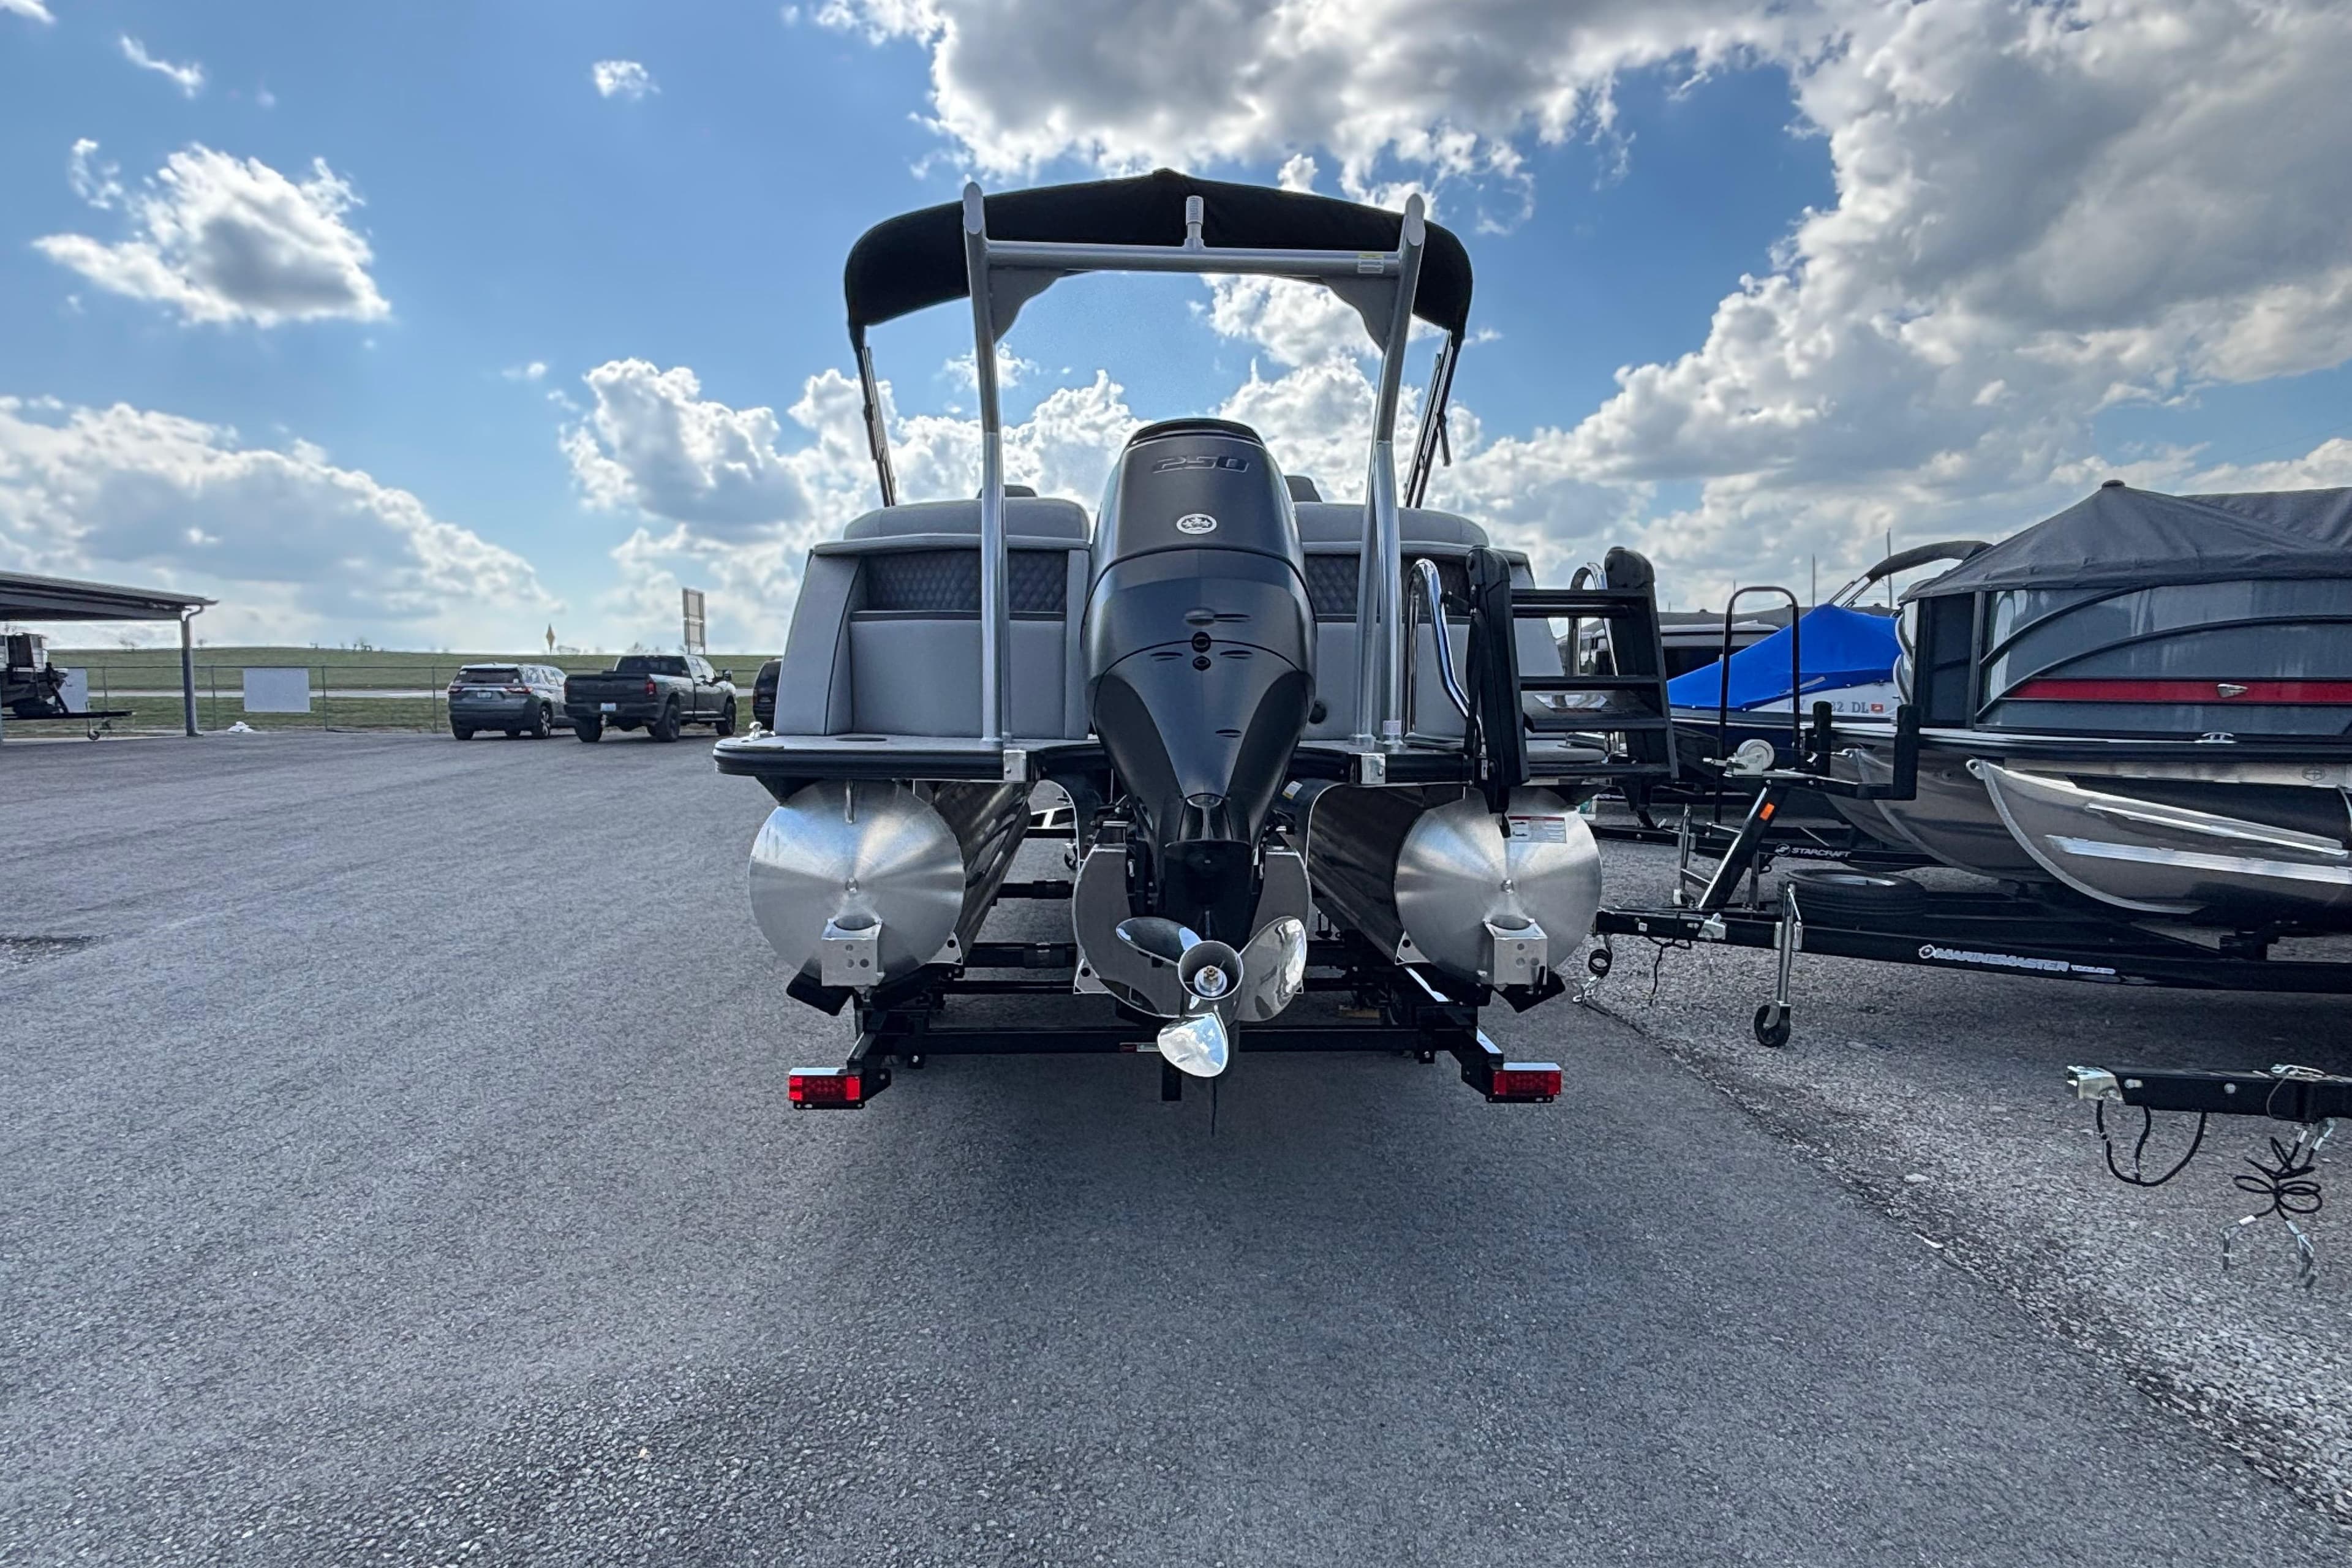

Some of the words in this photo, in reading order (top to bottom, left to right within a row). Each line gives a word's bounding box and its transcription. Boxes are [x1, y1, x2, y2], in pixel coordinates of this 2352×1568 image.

[1150, 455, 1250, 473] 250
[1852, 701, 1869, 714] DL
[1792, 847, 1852, 858] STARCRAFT
